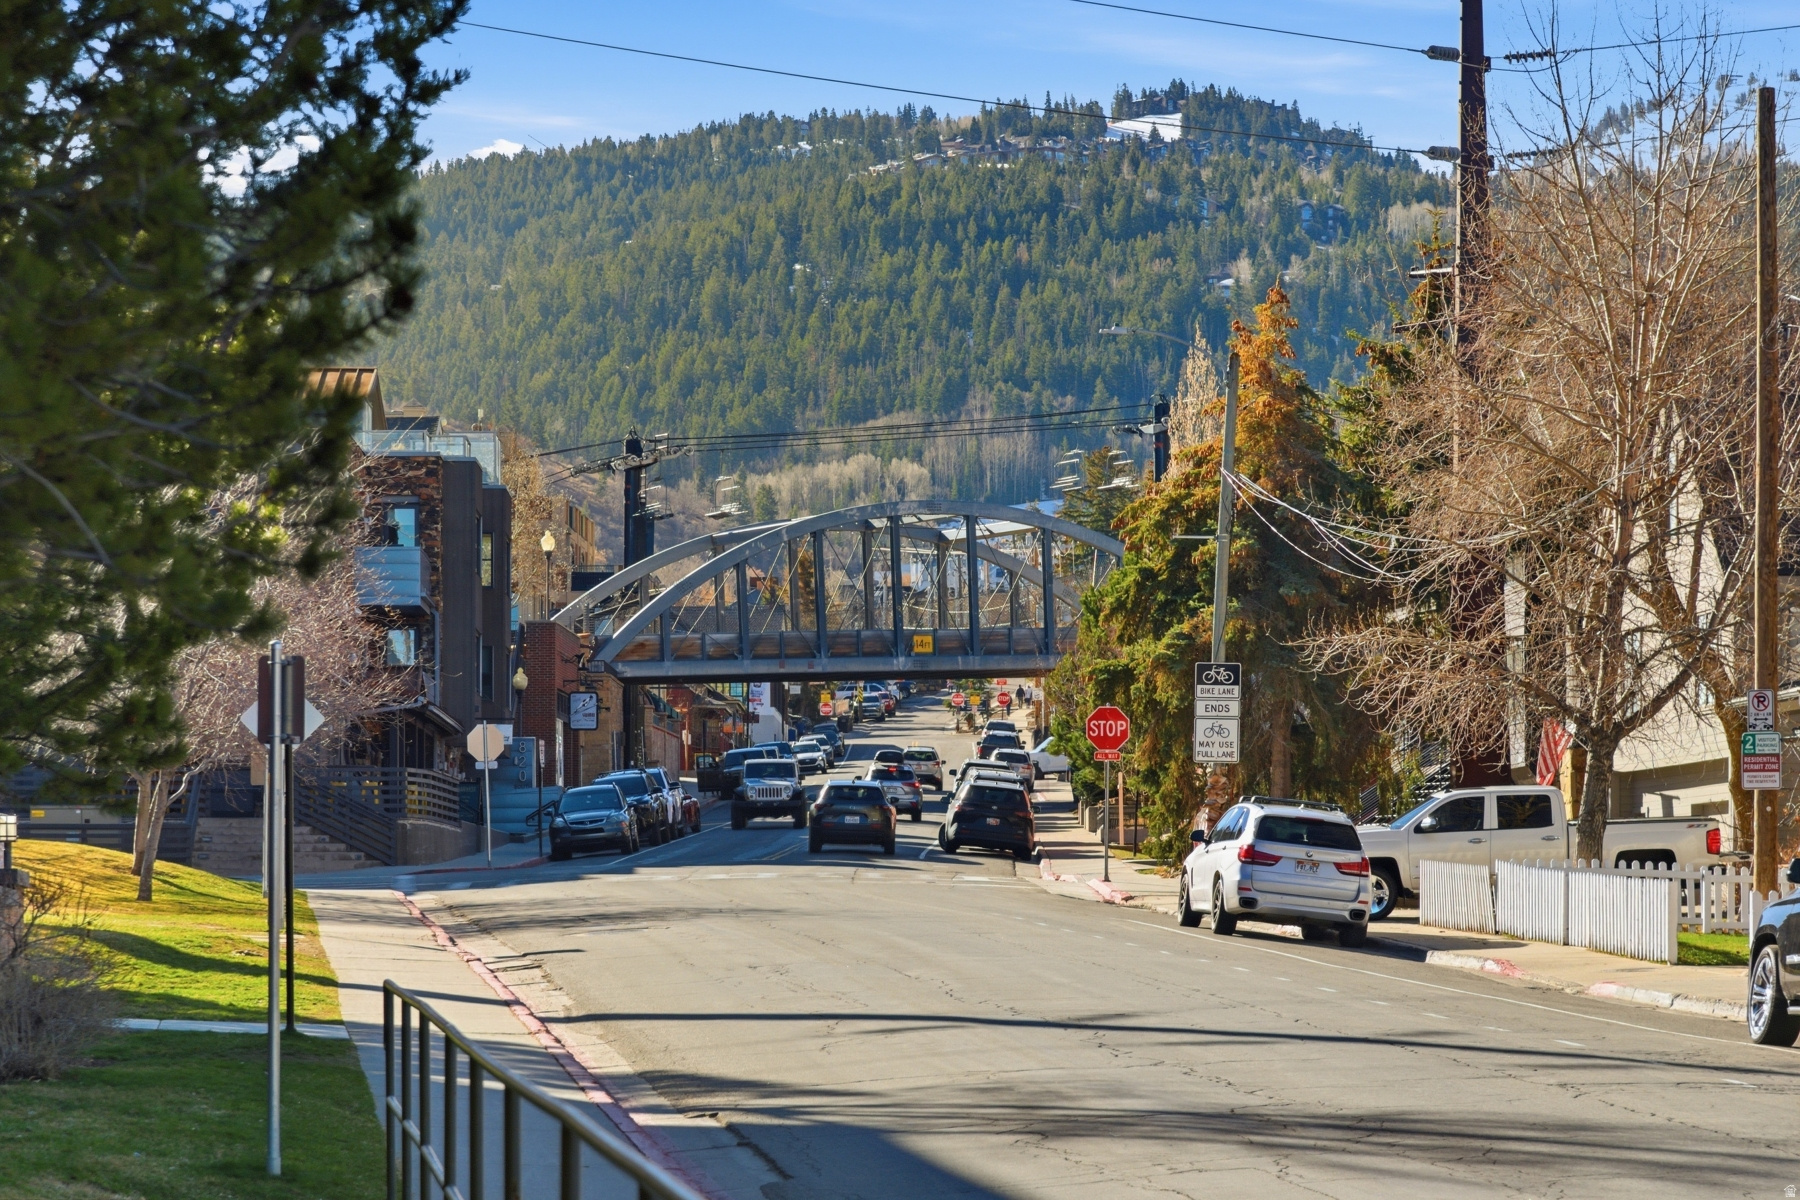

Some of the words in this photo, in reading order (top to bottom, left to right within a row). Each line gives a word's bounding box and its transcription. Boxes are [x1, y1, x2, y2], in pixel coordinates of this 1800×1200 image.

[1200, 687, 1215, 695] BIKE
[1204, 704, 1230, 713] ENDS
[1089, 720, 1127, 737] STOP
[1744, 735, 1754, 749] 2
